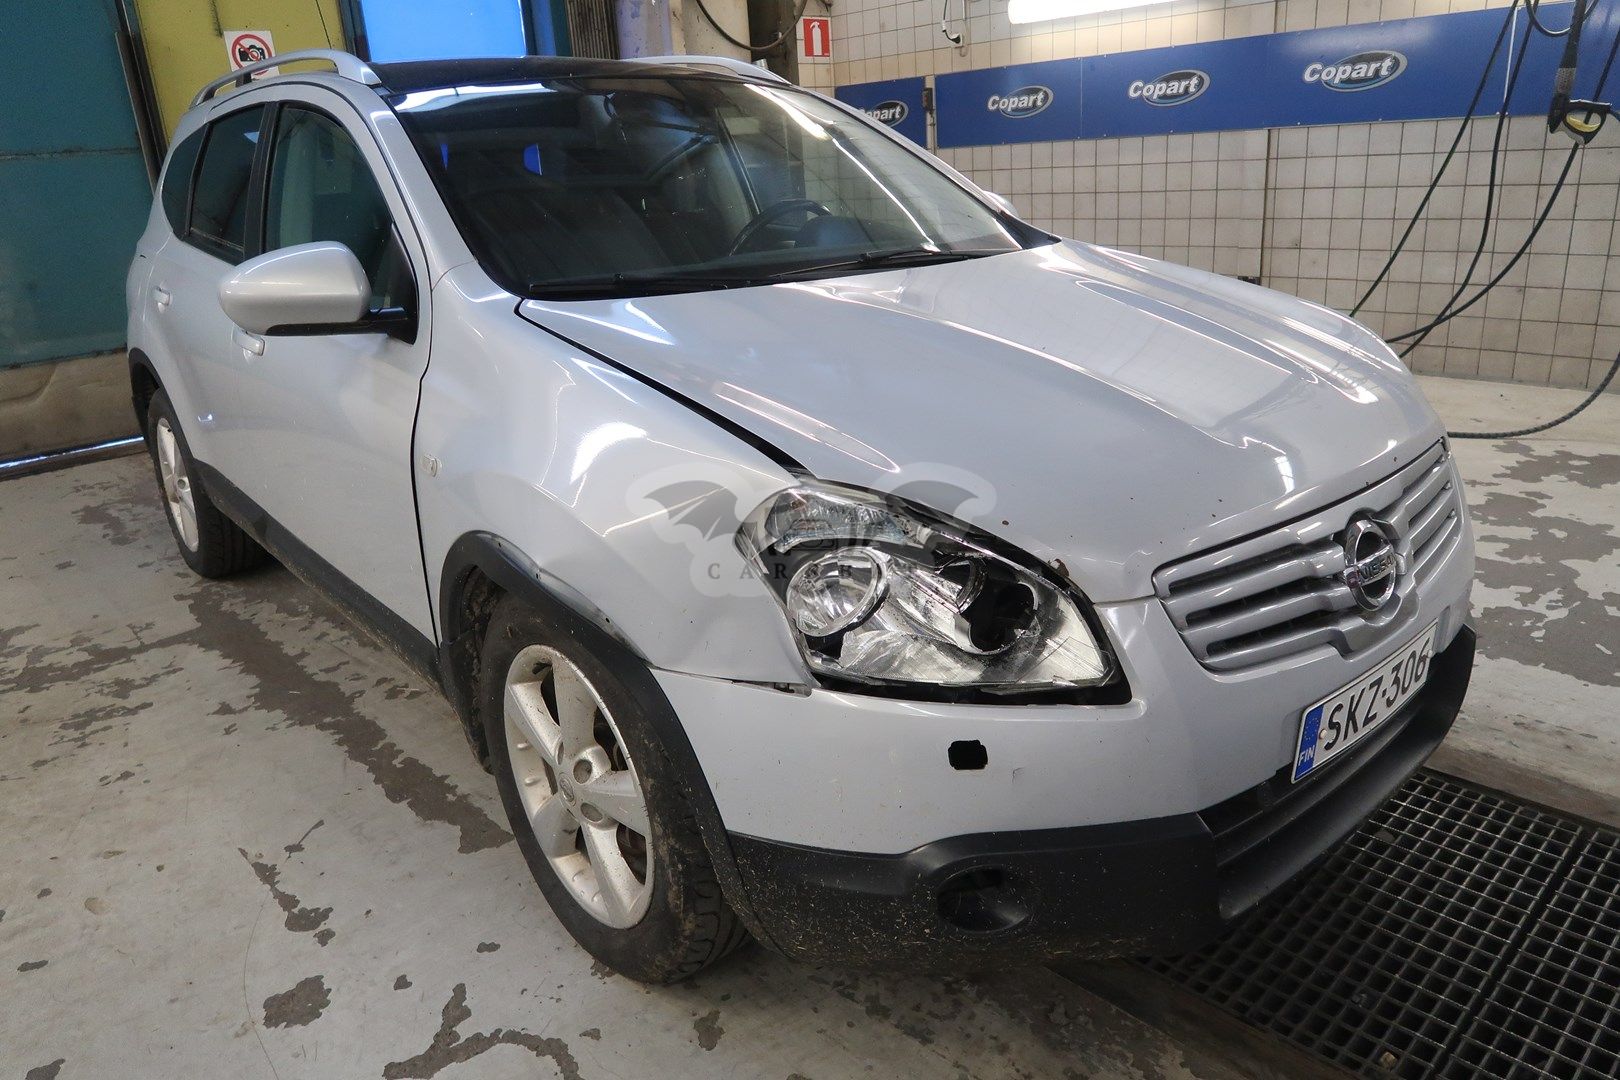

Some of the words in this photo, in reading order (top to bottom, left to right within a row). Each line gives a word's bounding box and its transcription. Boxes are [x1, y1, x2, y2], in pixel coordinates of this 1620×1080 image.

[1303, 57, 1394, 84] Copart
[1128, 76, 1199, 100] Copart
[859, 105, 902, 120] opart
[987, 91, 1045, 112] Copart
[1324, 637, 1431, 751] SKZ-306
[1298, 744, 1316, 767] FIN
